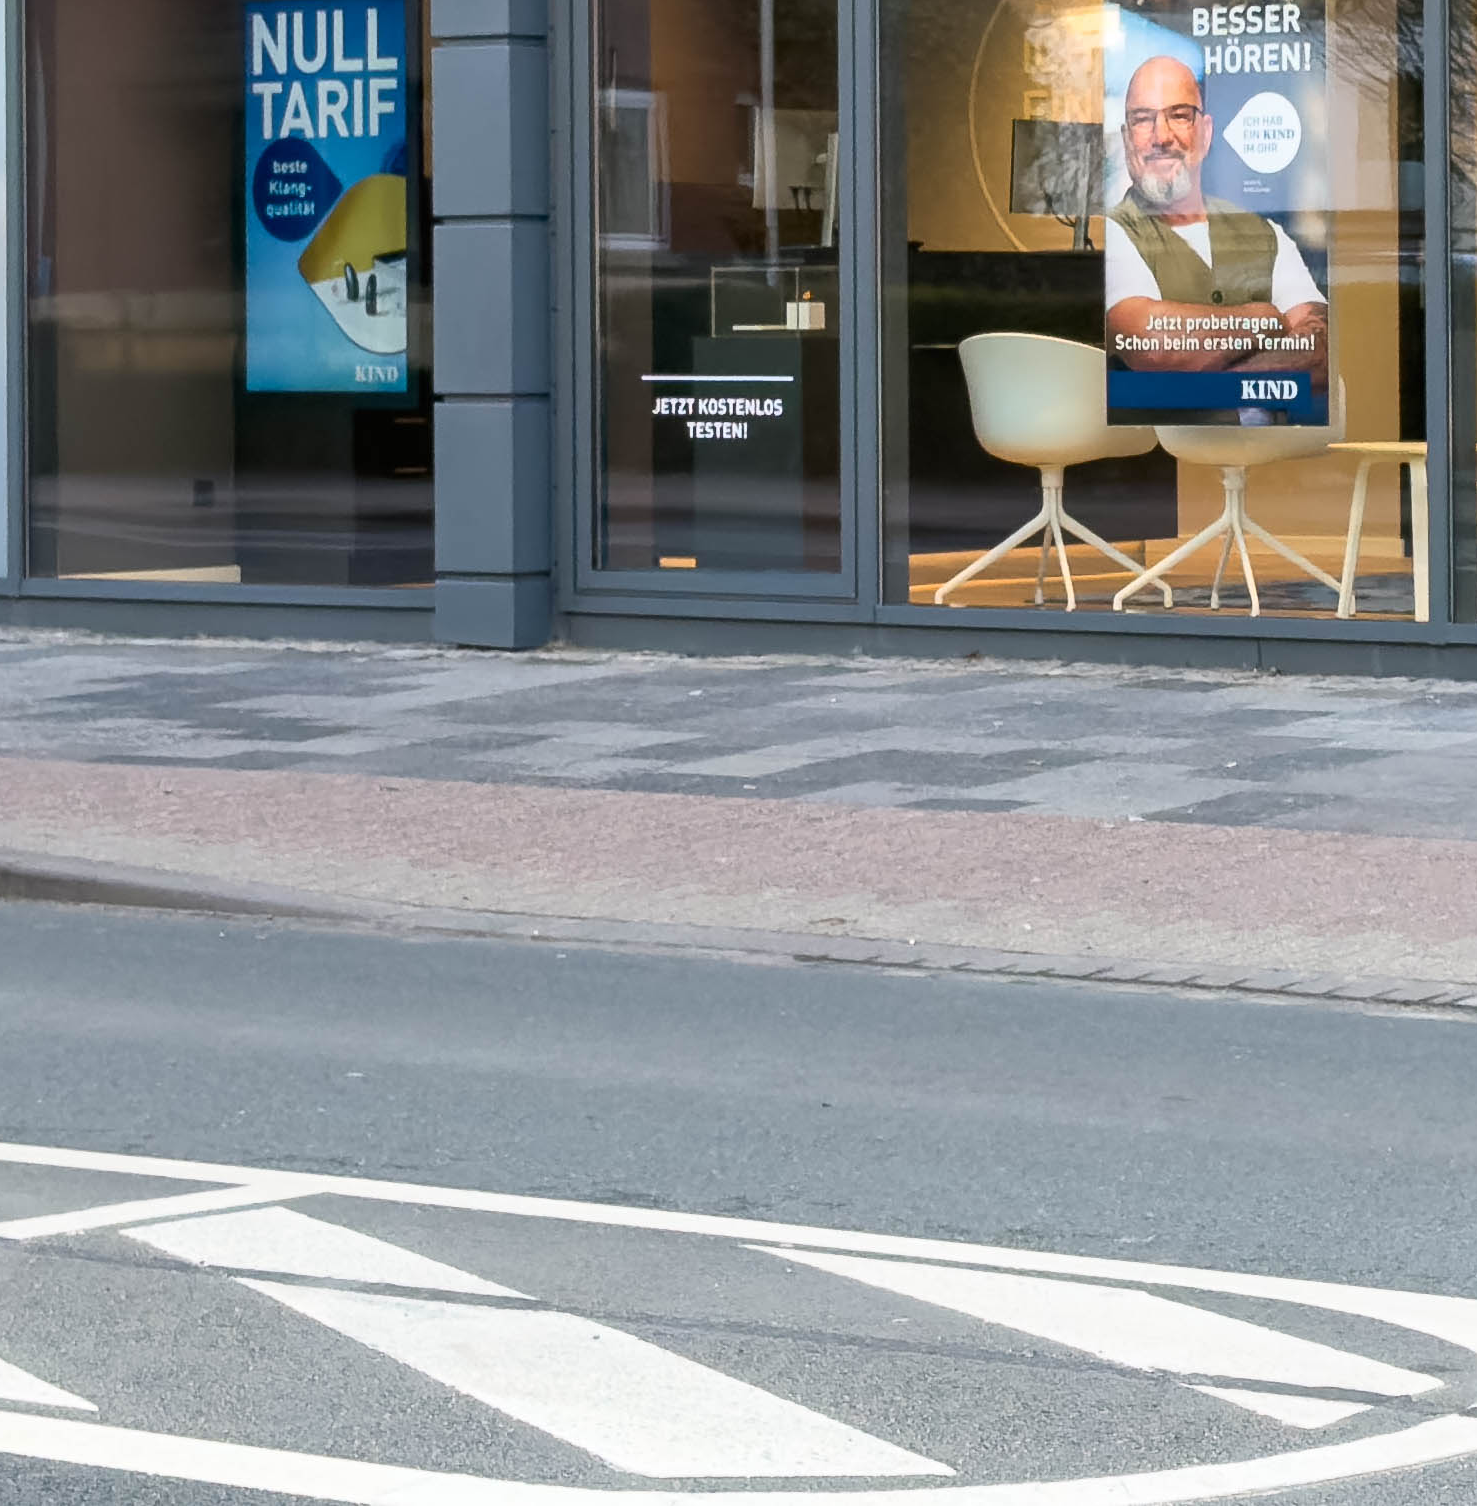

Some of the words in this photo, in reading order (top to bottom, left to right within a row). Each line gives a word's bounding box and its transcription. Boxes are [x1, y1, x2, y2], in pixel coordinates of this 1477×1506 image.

[1192, 4, 1302, 37] BESSER
[250, 8, 399, 75] NULL
[1203, 37, 1311, 75] HÖREN!
[251, 78, 400, 141] TARIF
[1263, 129, 1295, 139] KIND
[273, 160, 308, 174] beste
[269, 180, 312, 197] Klang-
[266, 201, 315, 218] qualität
[1145, 314, 1181, 334] Jetzt
[1185, 315, 1284, 336] probetragen.
[1115, 334, 1160, 352] Schon
[1163, 333, 1200, 352] beim
[1203, 336, 1253, 352] ersten
[1256, 332, 1316, 352] Termin!
[355, 365, 399, 383] KIND
[1240, 379, 1299, 400] KIND
[652, 398, 694, 415] JETZT
[698, 398, 783, 416] KOSTENLOS
[687, 422, 747, 439] TESTEN!
